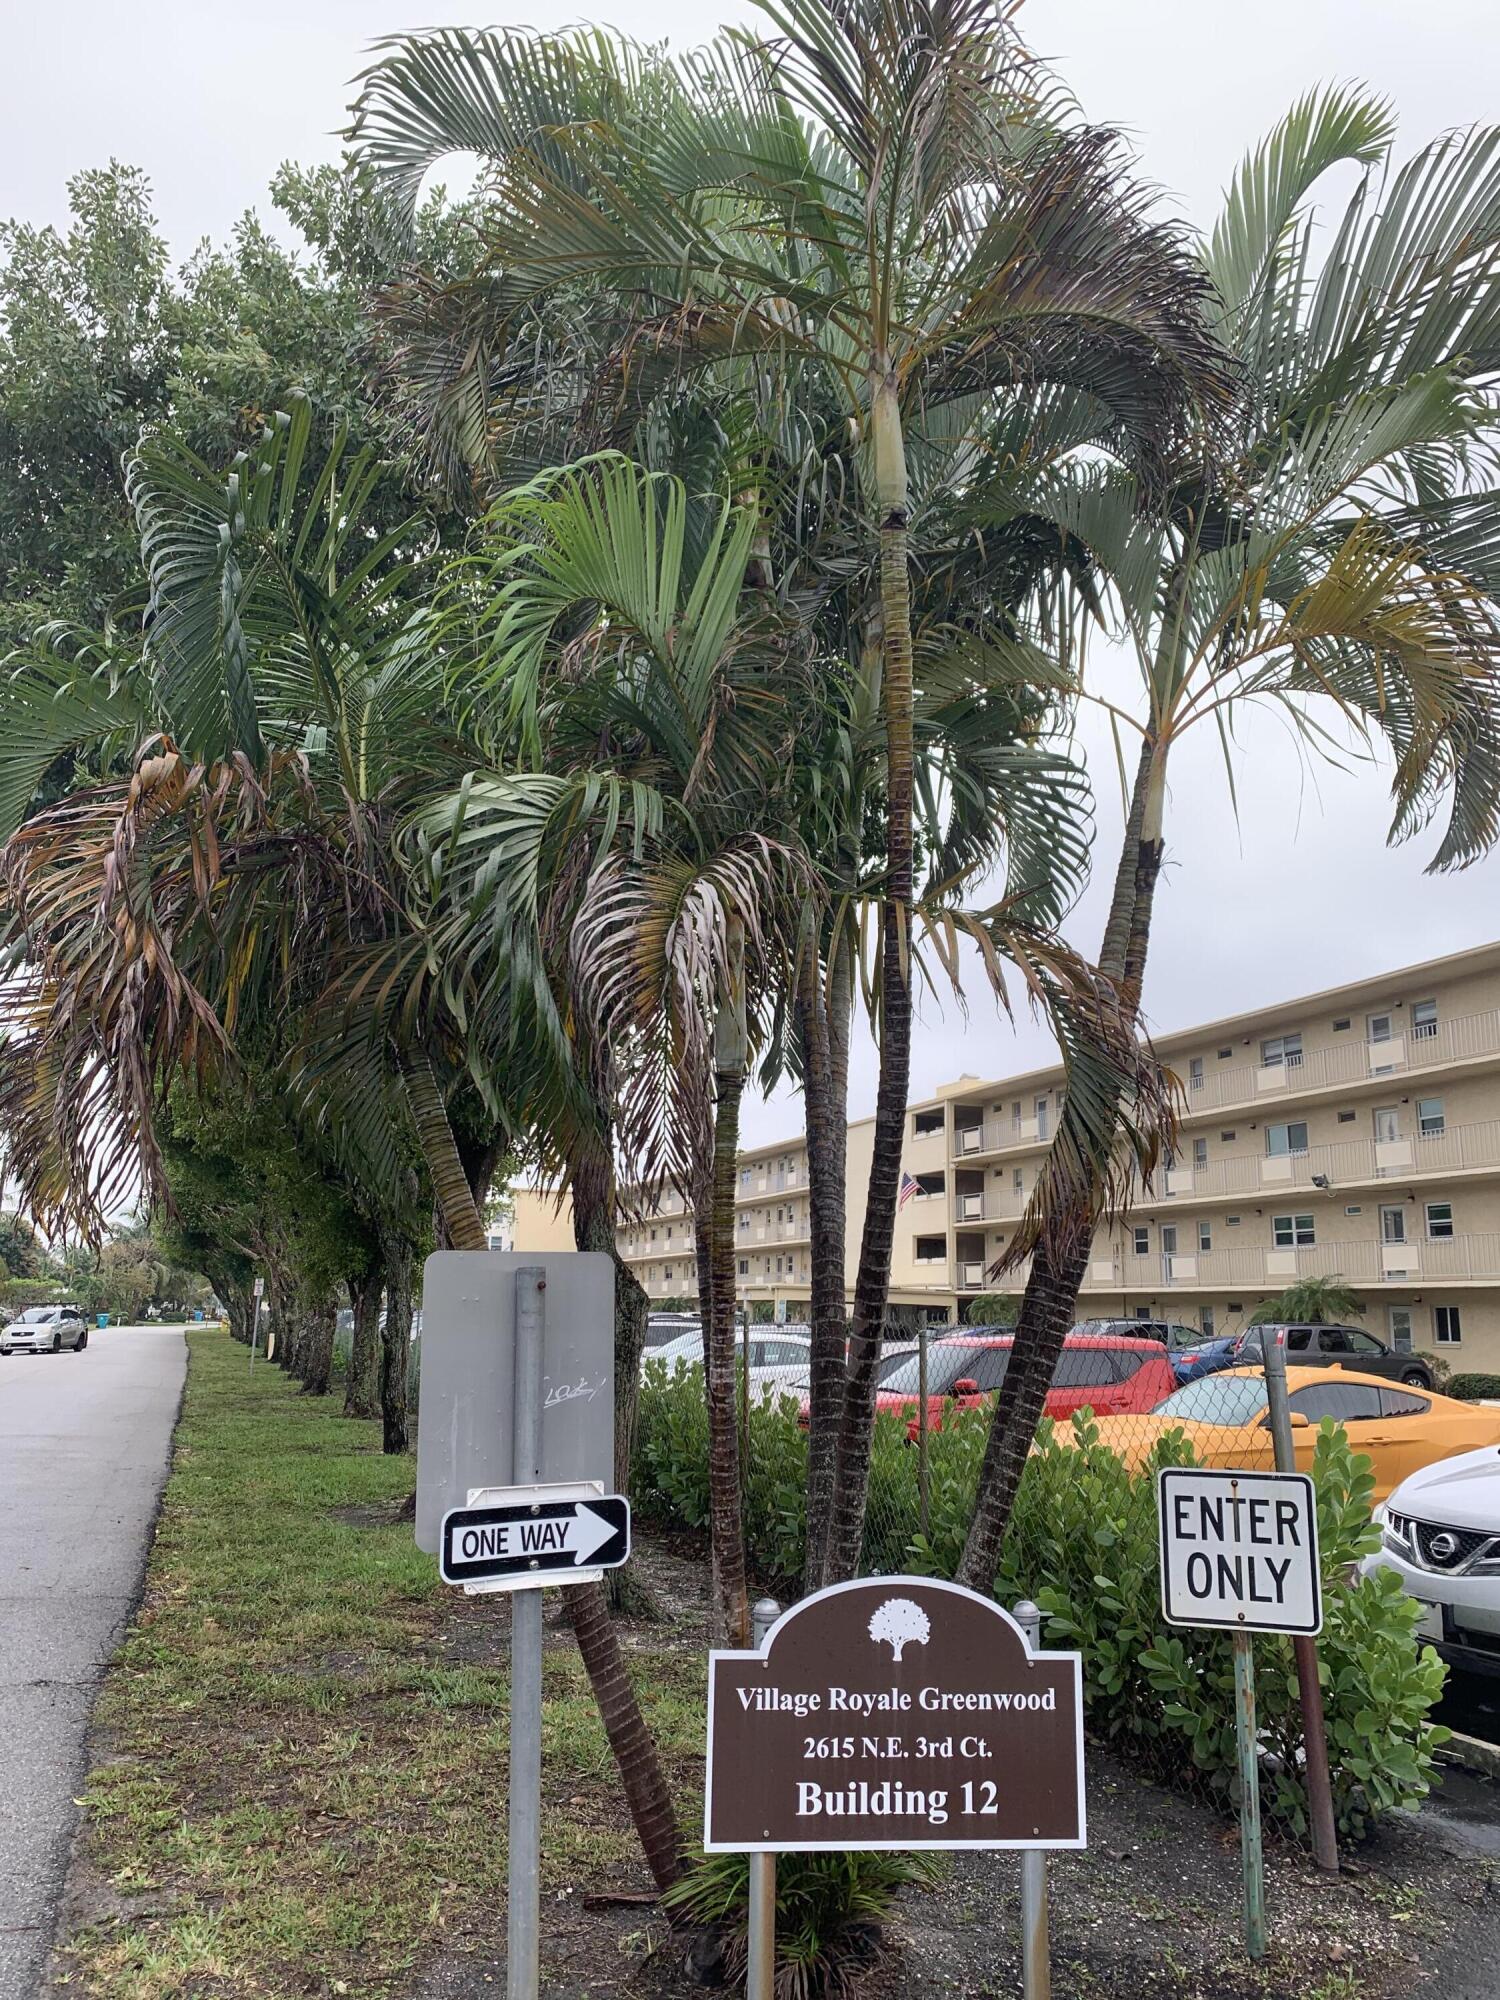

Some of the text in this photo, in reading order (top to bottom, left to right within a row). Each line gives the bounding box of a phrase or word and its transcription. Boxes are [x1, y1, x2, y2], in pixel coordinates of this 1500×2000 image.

[462, 1521, 570, 1558] ONE WAY
[1174, 1495, 1301, 1546] ENTER
[1187, 1552, 1292, 1604] ONLY
[736, 1687, 1056, 1717] Village Royale Greenwood
[803, 1737, 993, 1759] 2615 N.E. 3rd Ct.
[796, 1781, 999, 1824] Building 12
